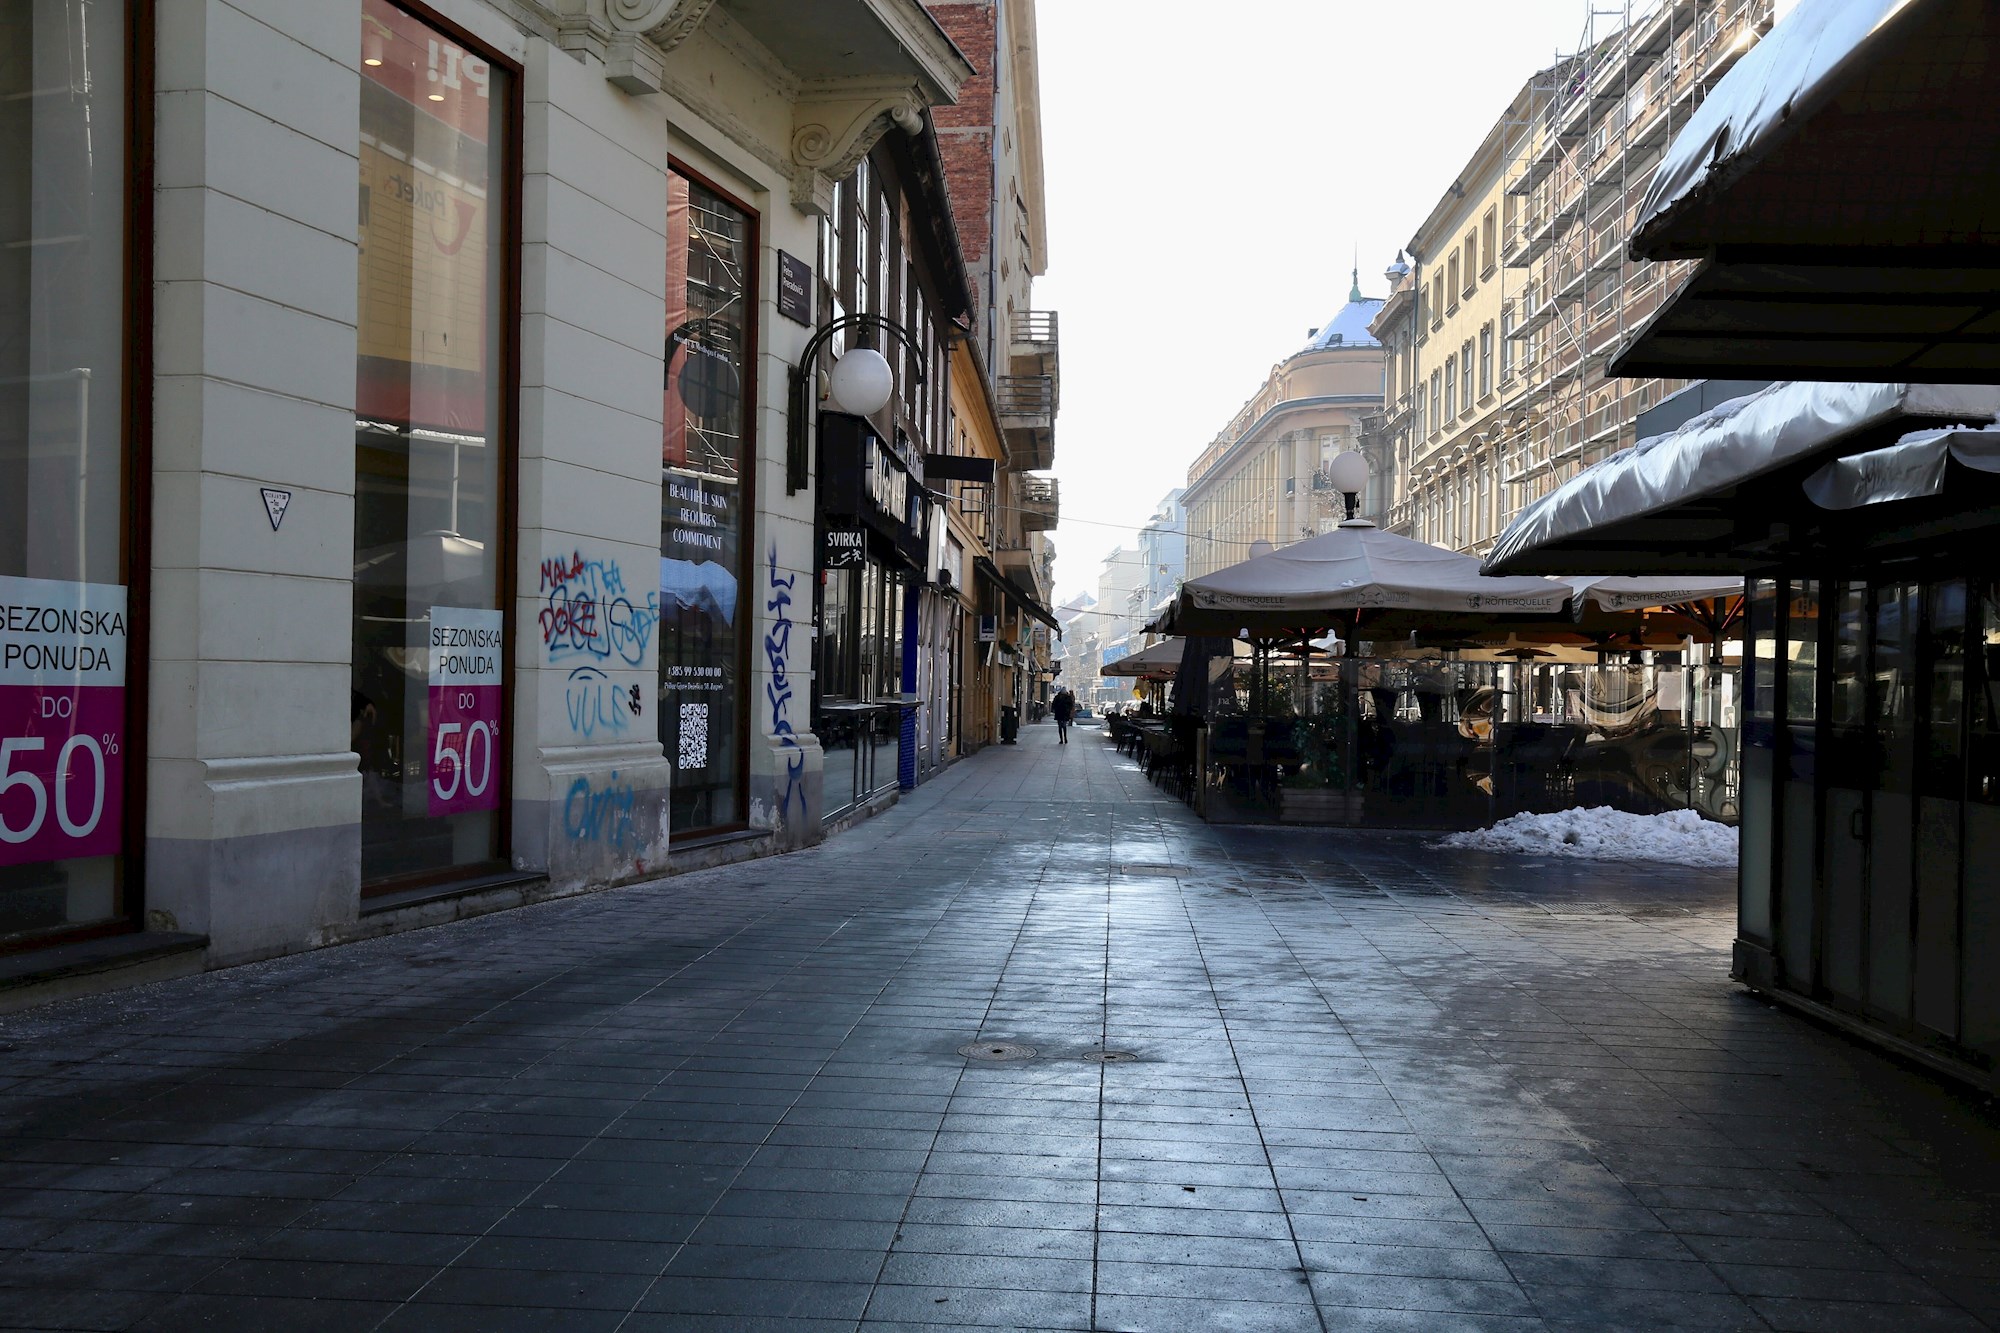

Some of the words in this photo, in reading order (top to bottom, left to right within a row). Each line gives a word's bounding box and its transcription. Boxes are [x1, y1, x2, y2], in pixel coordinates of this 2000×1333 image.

[669, 483, 709, 506] BEAUTIFUL
[711, 493, 728, 509] SKIN
[680, 507, 717, 528] REQUIRES
[672, 527, 722, 550] COMMITMENT
[827, 531, 863, 547] SVIRKA
[431, 627, 503, 649] SEZONSKA
[5, 643, 111, 672] PONUDA
[439, 655, 494, 675] PONUDA
[42, 696, 73, 718] DO
[458, 692, 475, 710] DO
